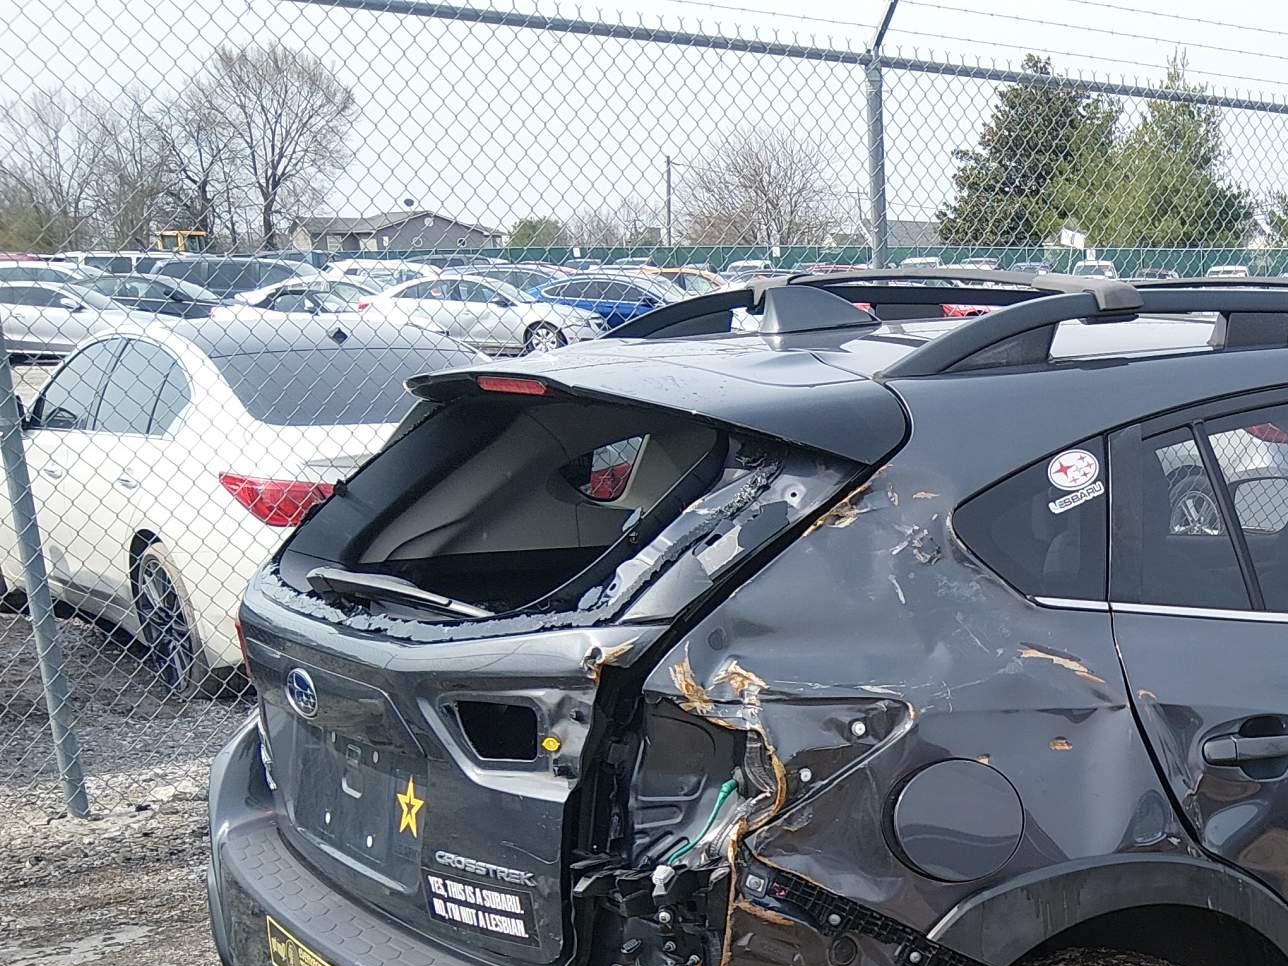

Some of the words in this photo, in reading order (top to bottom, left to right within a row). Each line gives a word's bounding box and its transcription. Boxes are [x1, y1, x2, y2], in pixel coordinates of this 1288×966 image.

[434, 850, 538, 887] CROSSTREK
[428, 874, 448, 899] YES,
[445, 879, 466, 901] THIS
[464, 884, 476, 905] IS
[475, 887, 484, 906] A
[482, 889, 525, 915] SUBARU.
[432, 897, 448, 919] NO,
[446, 901, 461, 921] I'M
[459, 905, 478, 926] NOT
[477, 910, 487, 928] A
[485, 912, 529, 938] LESBIAN.
